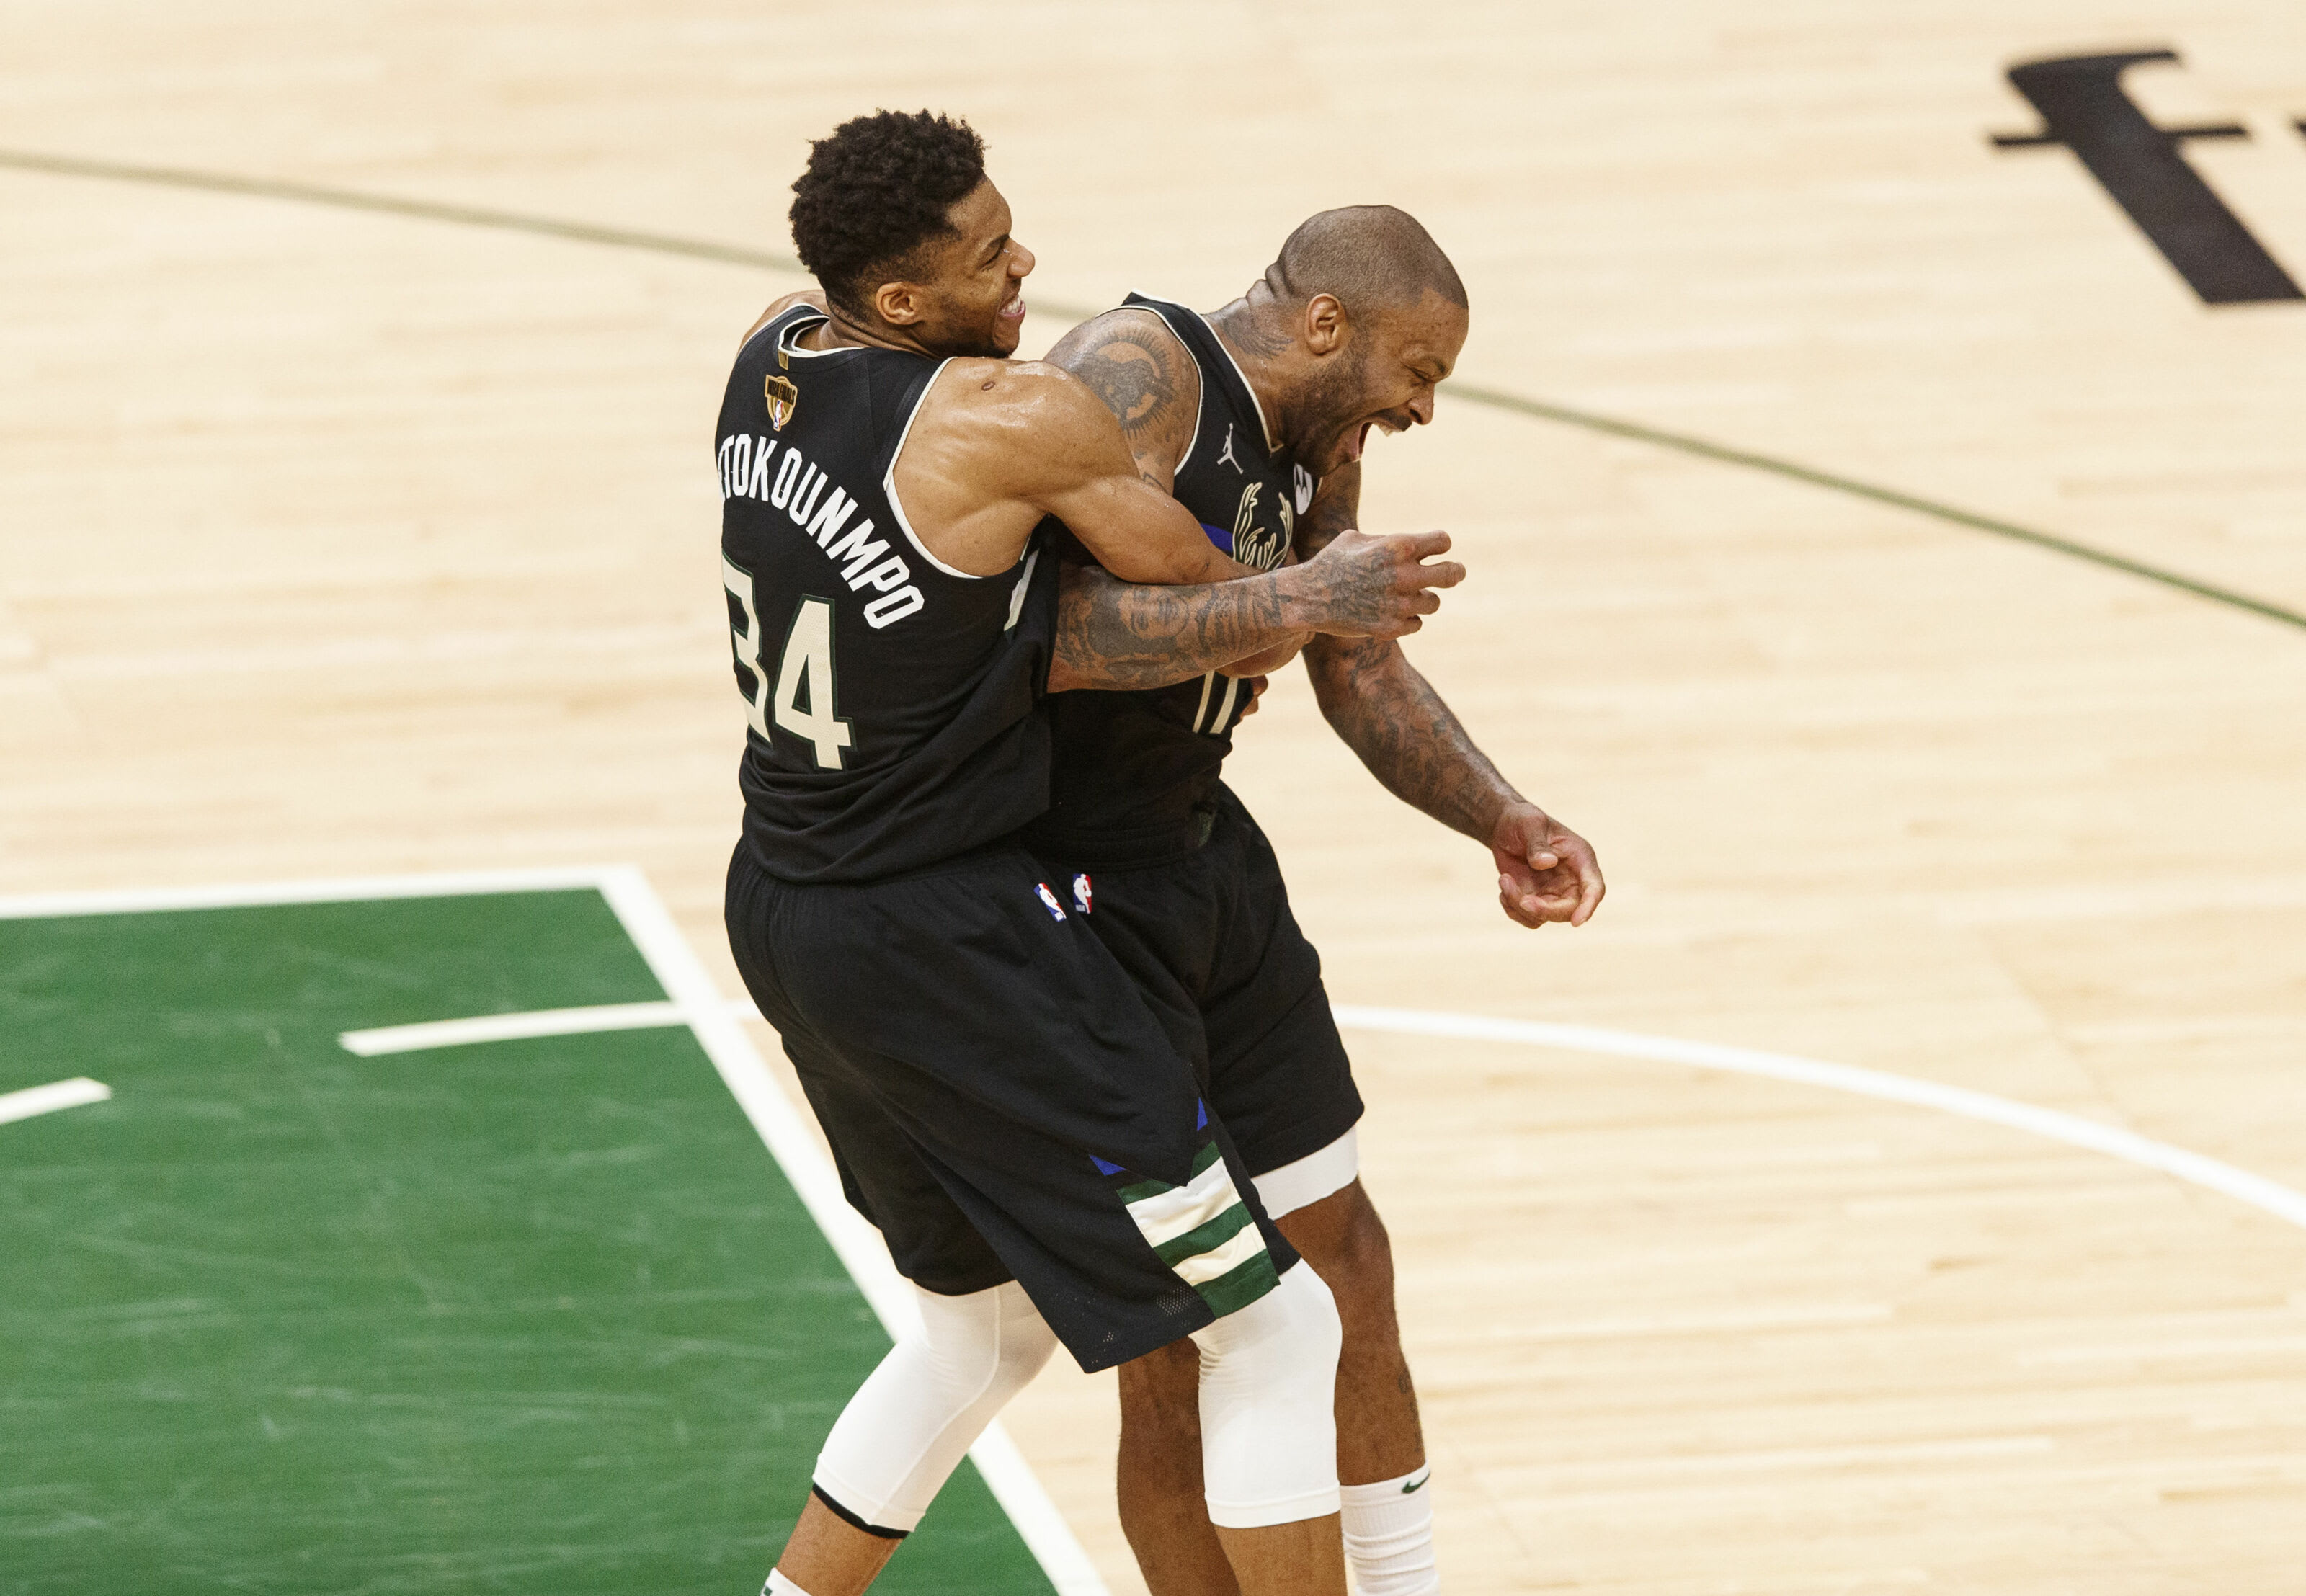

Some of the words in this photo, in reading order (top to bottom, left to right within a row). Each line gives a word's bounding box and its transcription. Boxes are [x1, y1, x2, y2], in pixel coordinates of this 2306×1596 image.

[1987, 48, 2306, 306] f
[718, 434, 925, 629] TOKOUNMPO
[721, 549, 856, 770] 34
